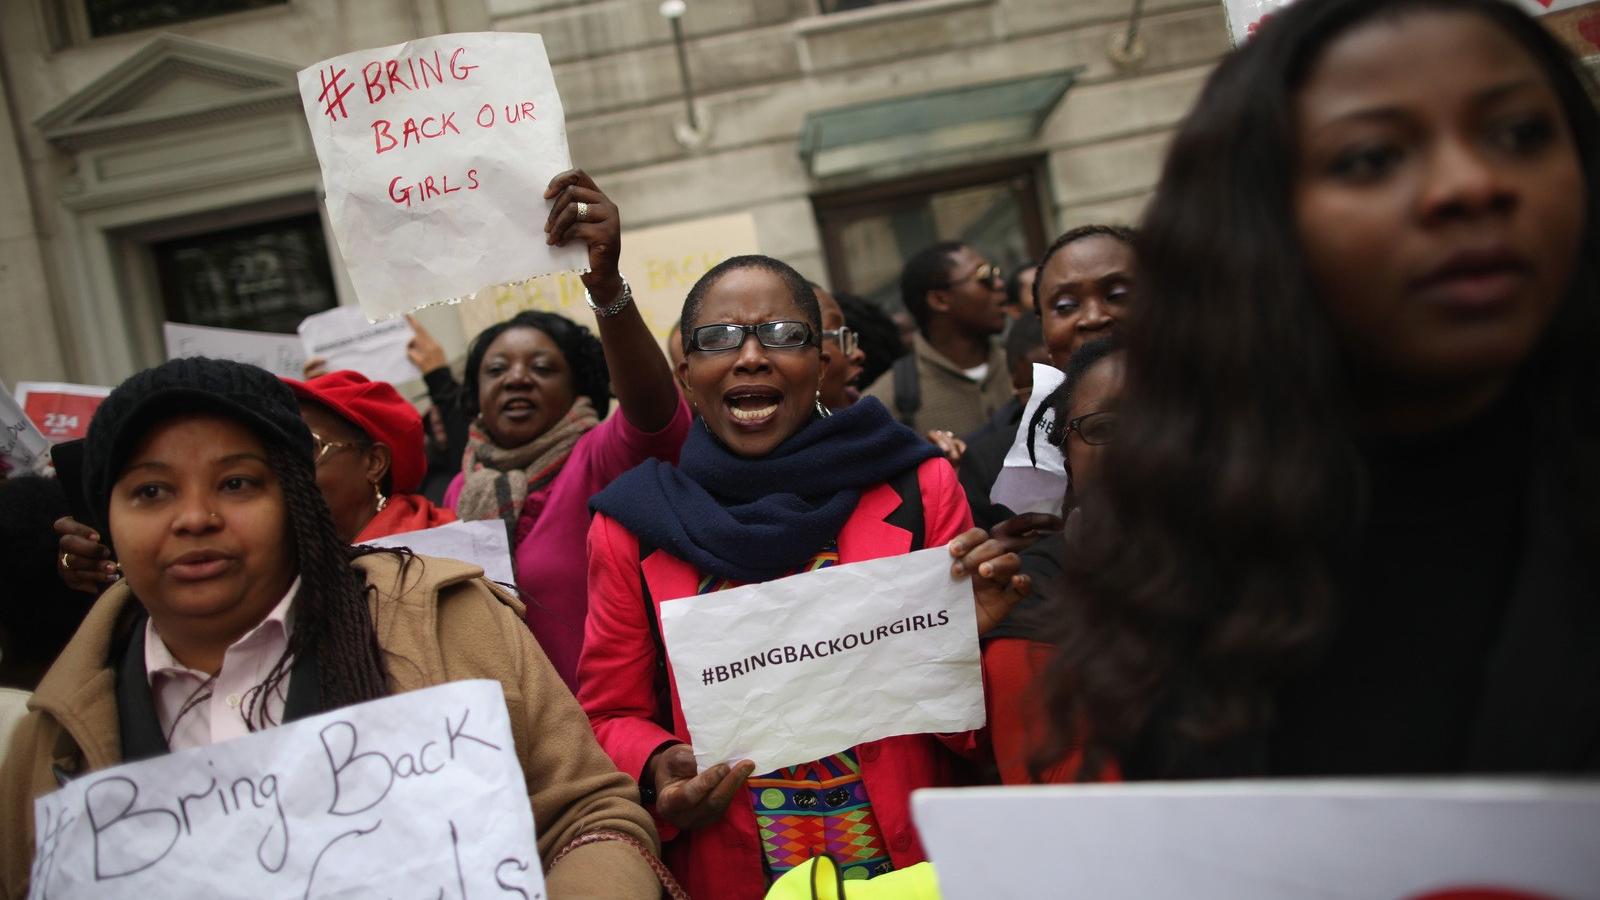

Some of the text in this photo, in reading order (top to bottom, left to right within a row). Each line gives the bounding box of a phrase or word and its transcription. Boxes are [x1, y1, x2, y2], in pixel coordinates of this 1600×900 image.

[318, 47, 479, 121] #BRING
[371, 101, 537, 154] BACK OUR
[388, 169, 480, 207] GIRLS
[701, 609, 950, 687] #BRINGBACKOURGIRLS
[319, 708, 502, 817] Back
